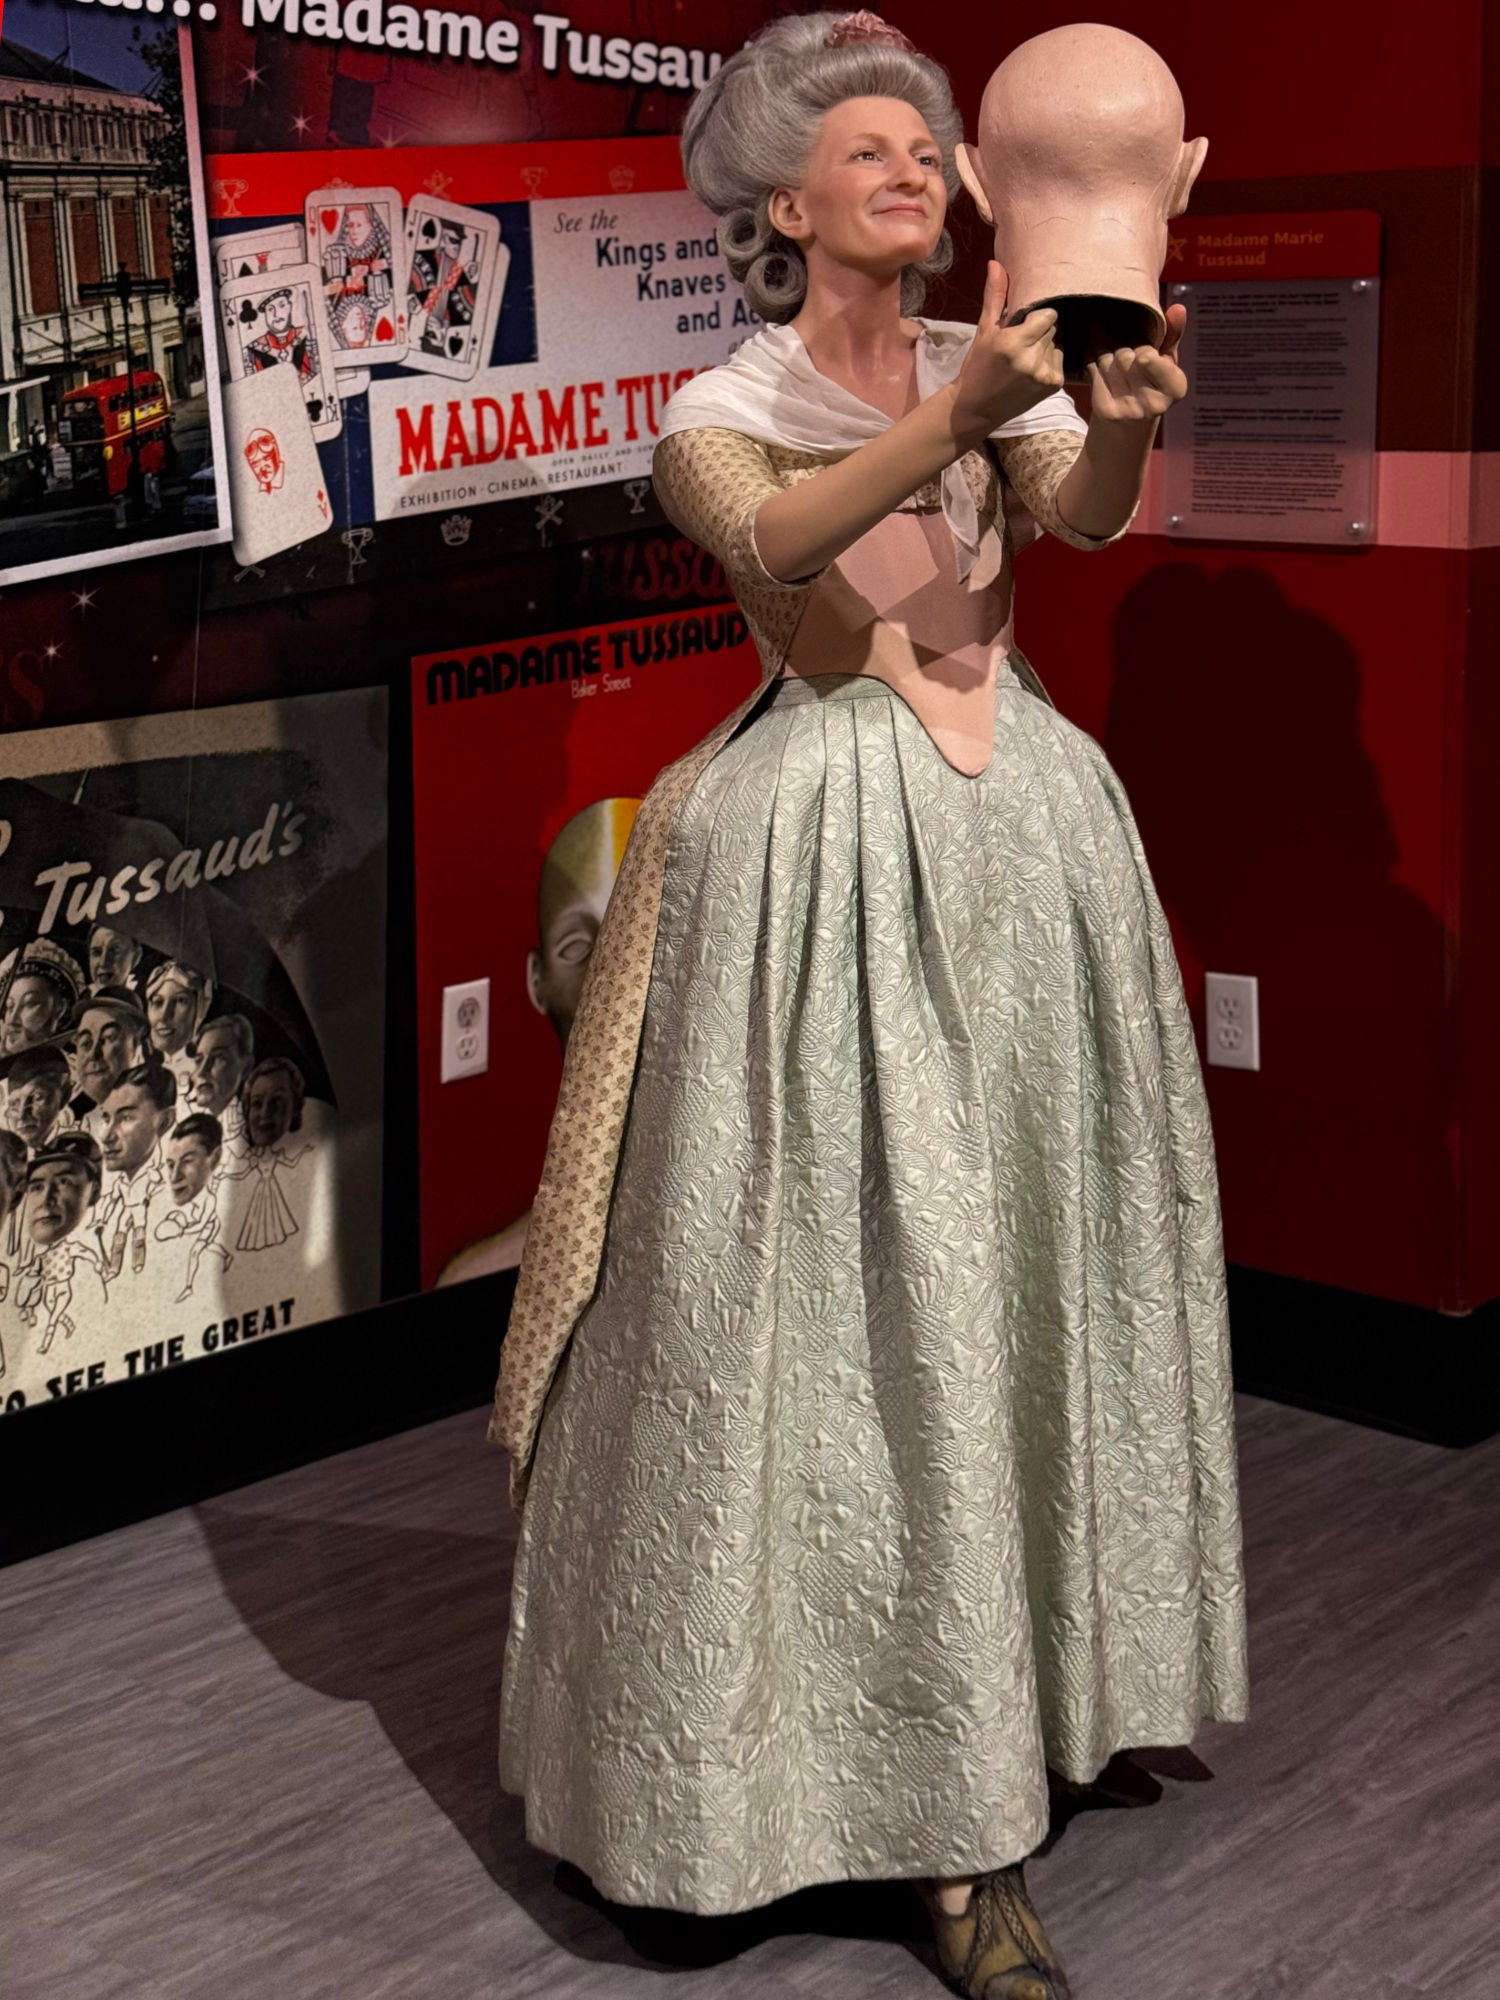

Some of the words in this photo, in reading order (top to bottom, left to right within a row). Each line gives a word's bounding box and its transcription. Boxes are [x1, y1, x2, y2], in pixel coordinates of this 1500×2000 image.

[241, 0, 519, 63] Madame
[533, 14, 724, 89] Tussau
[554, 212, 582, 233] See
[589, 209, 618, 230] the
[1197, 232, 1269, 248] Madame
[1274, 229, 1324, 245] Marie
[595, 237, 666, 270] Kings
[676, 228, 718, 259] and
[1197, 250, 1266, 267] Tussaud
[637, 272, 725, 301] Knaves
[677, 301, 720, 333] and
[732, 297, 760, 327] Ac
[396, 382, 609, 476] MADAME
[552, 456, 574, 466] OPEN
[582, 452, 609, 462] DAILY
[615, 448, 632, 456] AND
[400, 485, 476, 508] EXHIBITION
[487, 477, 537, 494] CINEMA
[547, 462, 623, 483] RESTAURANT
[427, 635, 601, 706] MADAME
[608, 610, 749, 670] TUSSAUD
[35, 801, 306, 935] Tussaud's
[46, 1361, 106, 1400] SEE
[125, 1335, 184, 1379] THE
[202, 1298, 295, 1352] GREAT
